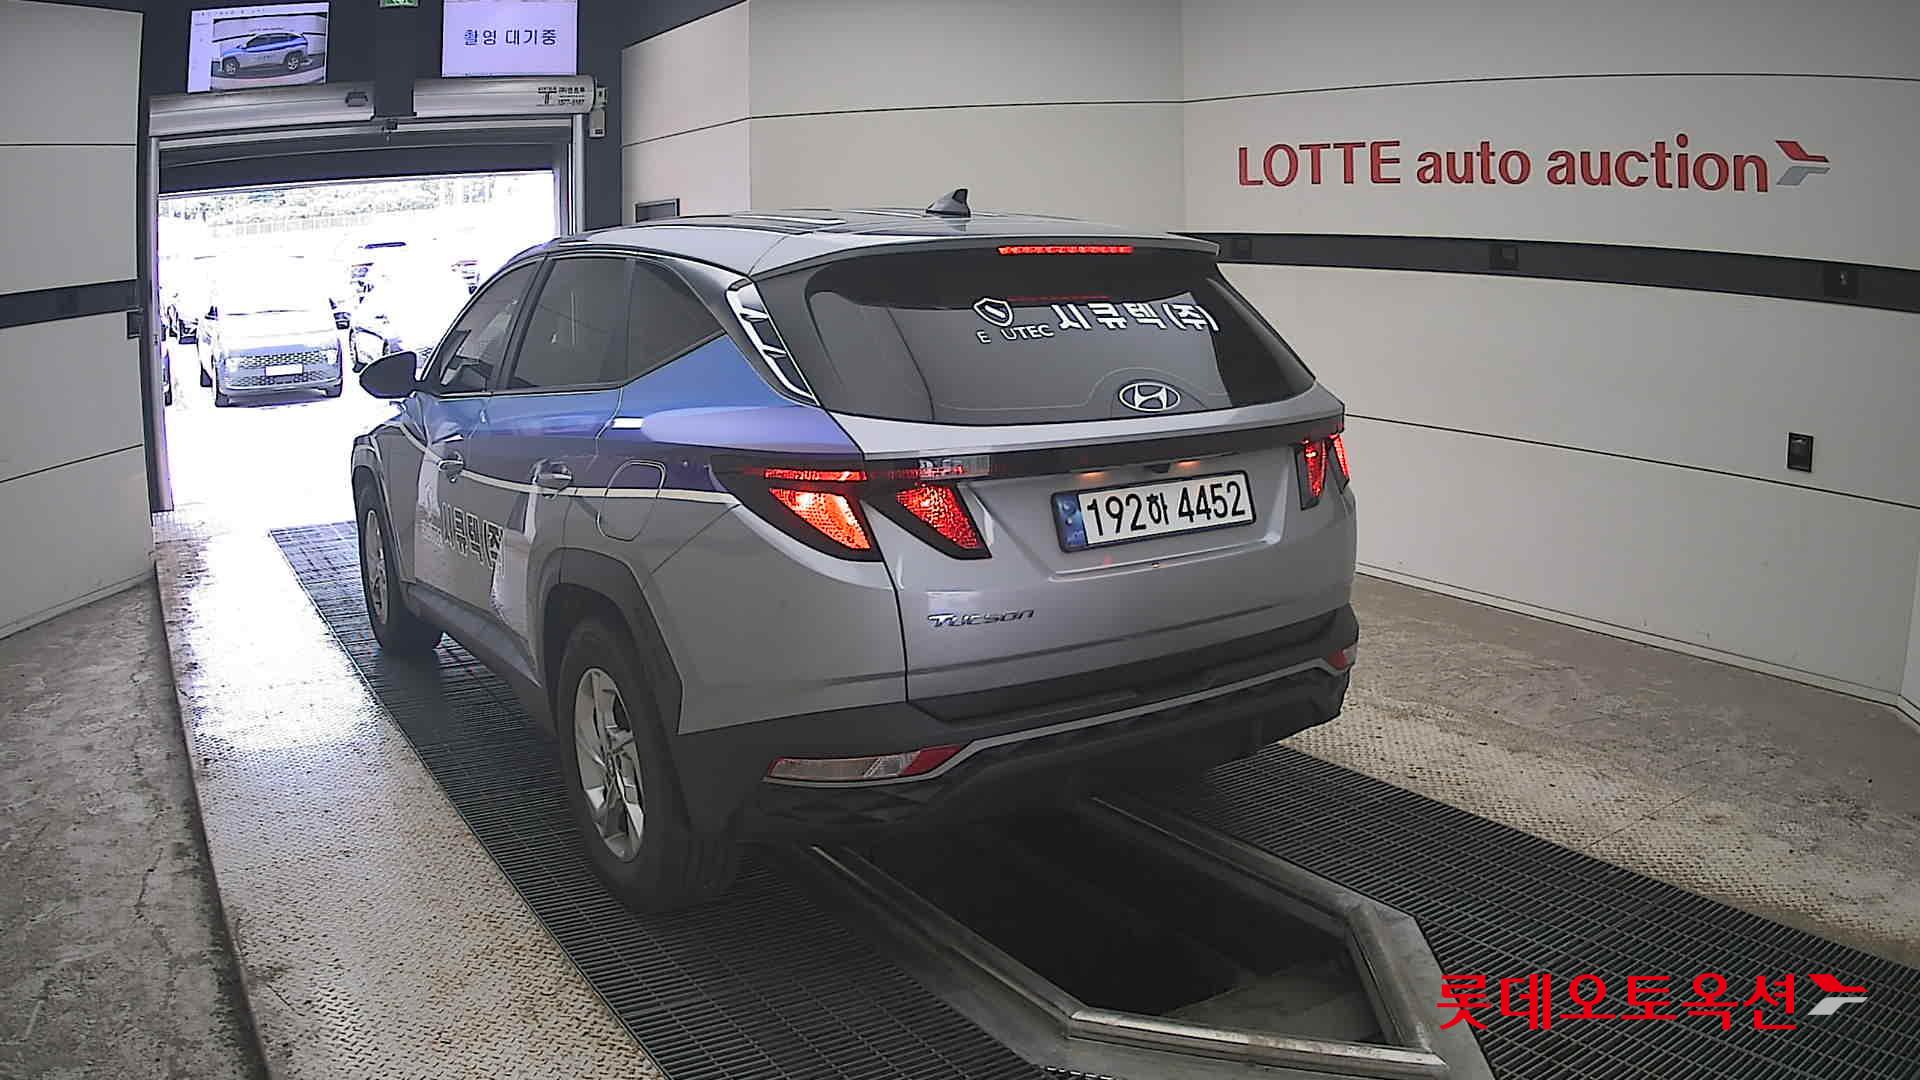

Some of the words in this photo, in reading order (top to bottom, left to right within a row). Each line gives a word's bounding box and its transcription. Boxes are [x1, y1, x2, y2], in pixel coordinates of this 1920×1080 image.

[505, 29, 557, 46] 대기중
[1237, 140, 1401, 188] LOTTE
[1416, 140, 1531, 185] auto
[1545, 133, 1769, 192] auction
[1086, 492, 1170, 537] 192하
[1177, 480, 1247, 523] 4452
